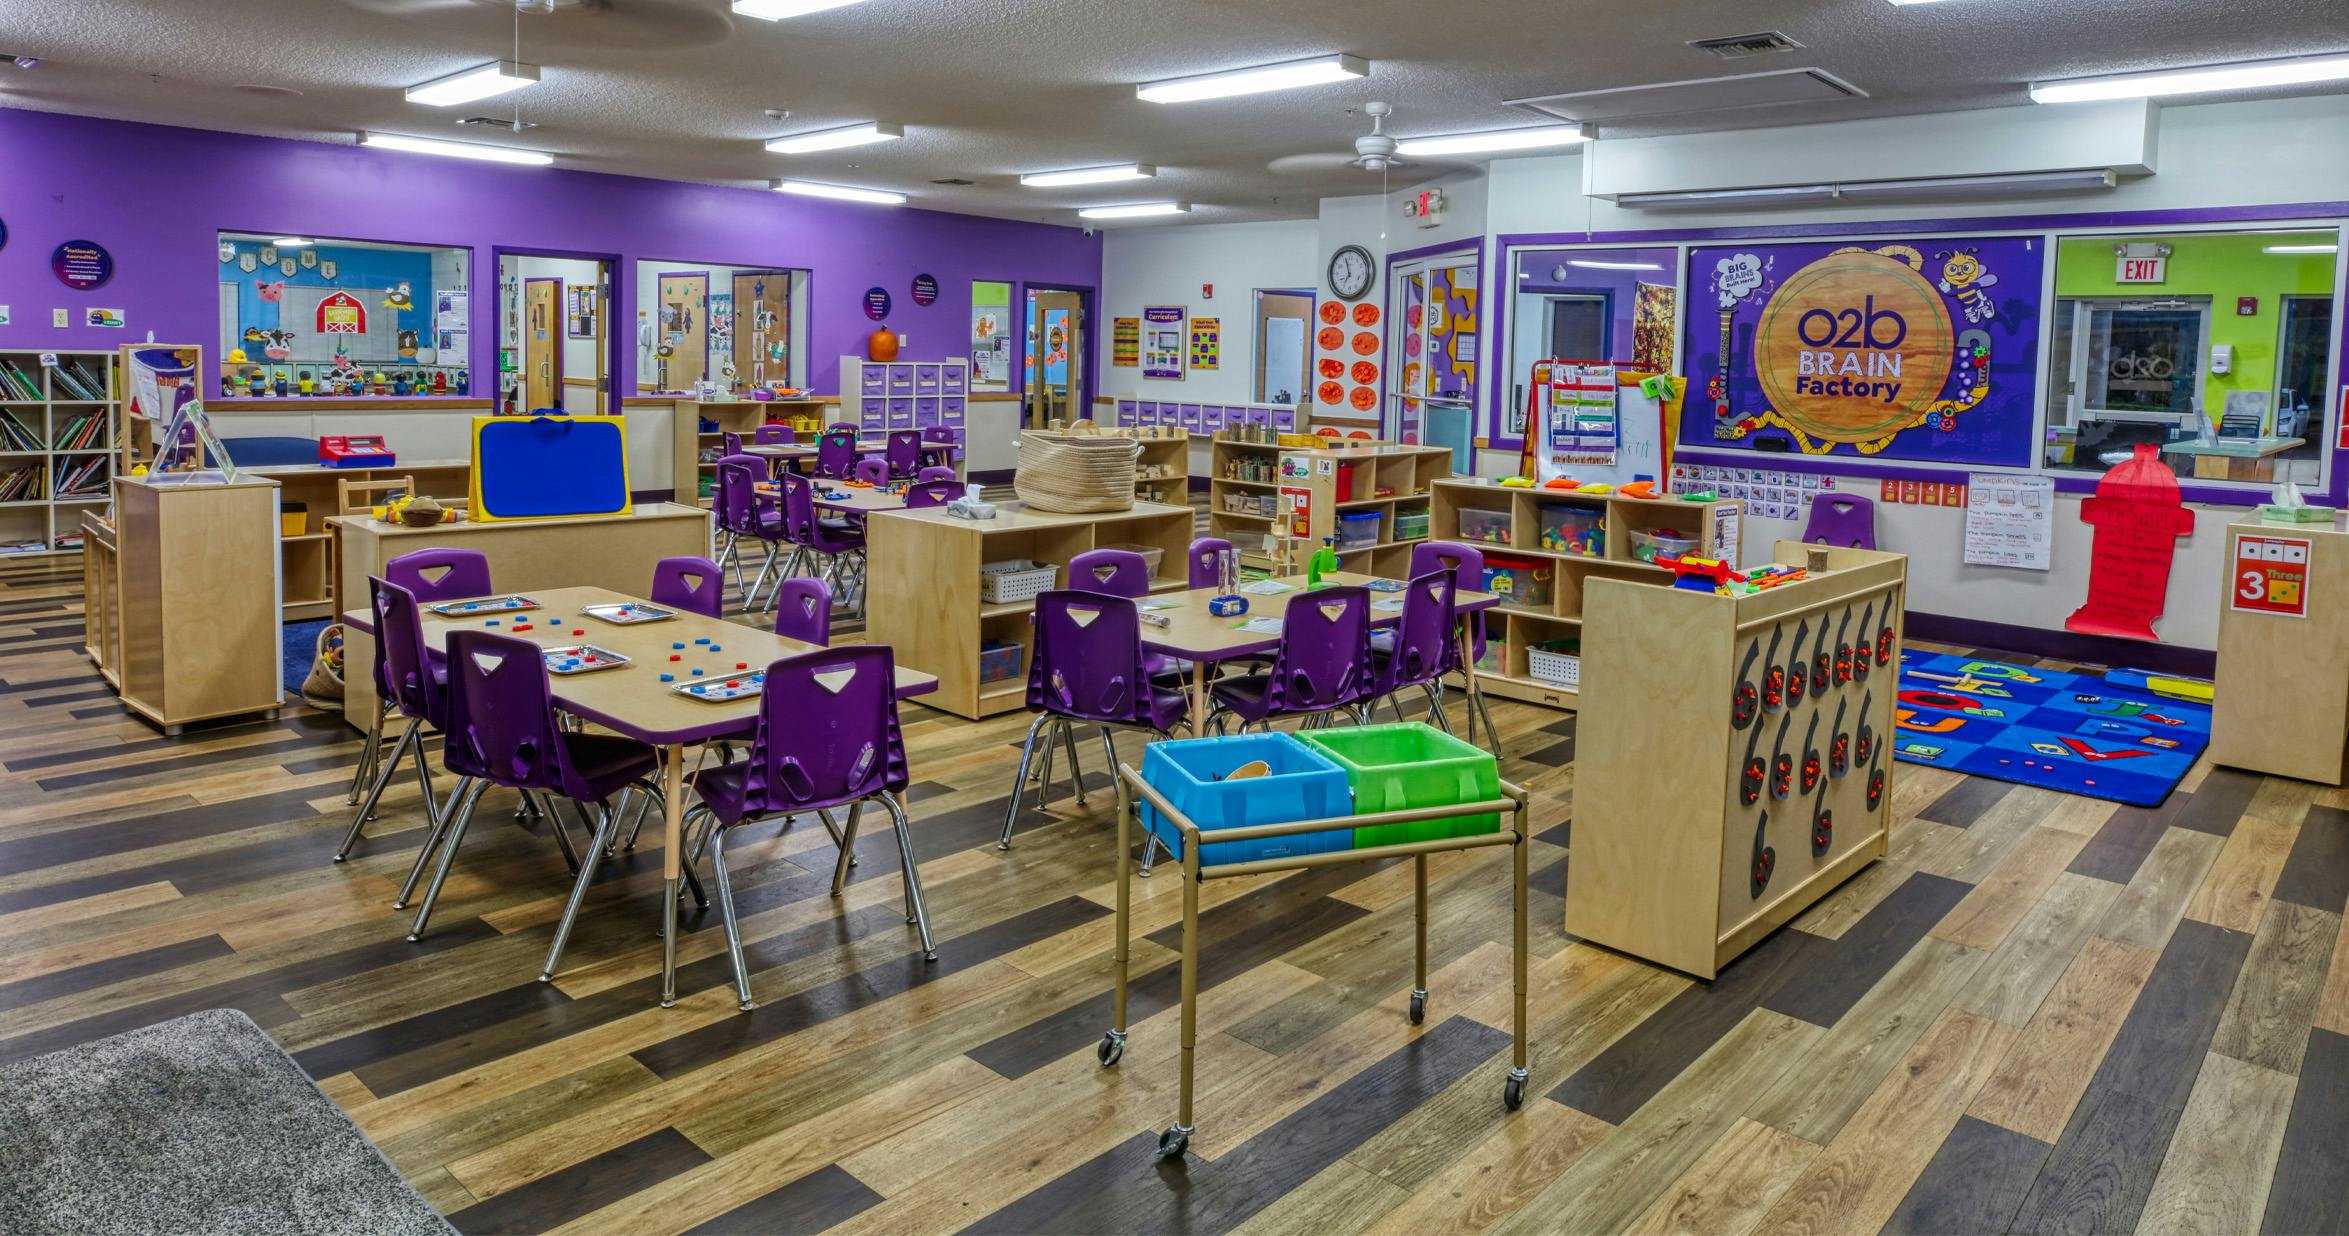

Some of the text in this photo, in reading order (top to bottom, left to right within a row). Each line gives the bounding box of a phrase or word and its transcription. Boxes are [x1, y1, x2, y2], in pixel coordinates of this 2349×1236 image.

[1725, 269, 1754, 282] BRAINS
[1728, 262, 1747, 273] BIG
[2125, 260, 2158, 280] EXIT
[1797, 294, 1907, 350] o2b
[1799, 351, 1901, 377] BRAIN
[1796, 376, 1902, 404] Factory
[2240, 571, 2265, 600] 3
[2267, 568, 2304, 581] Three
